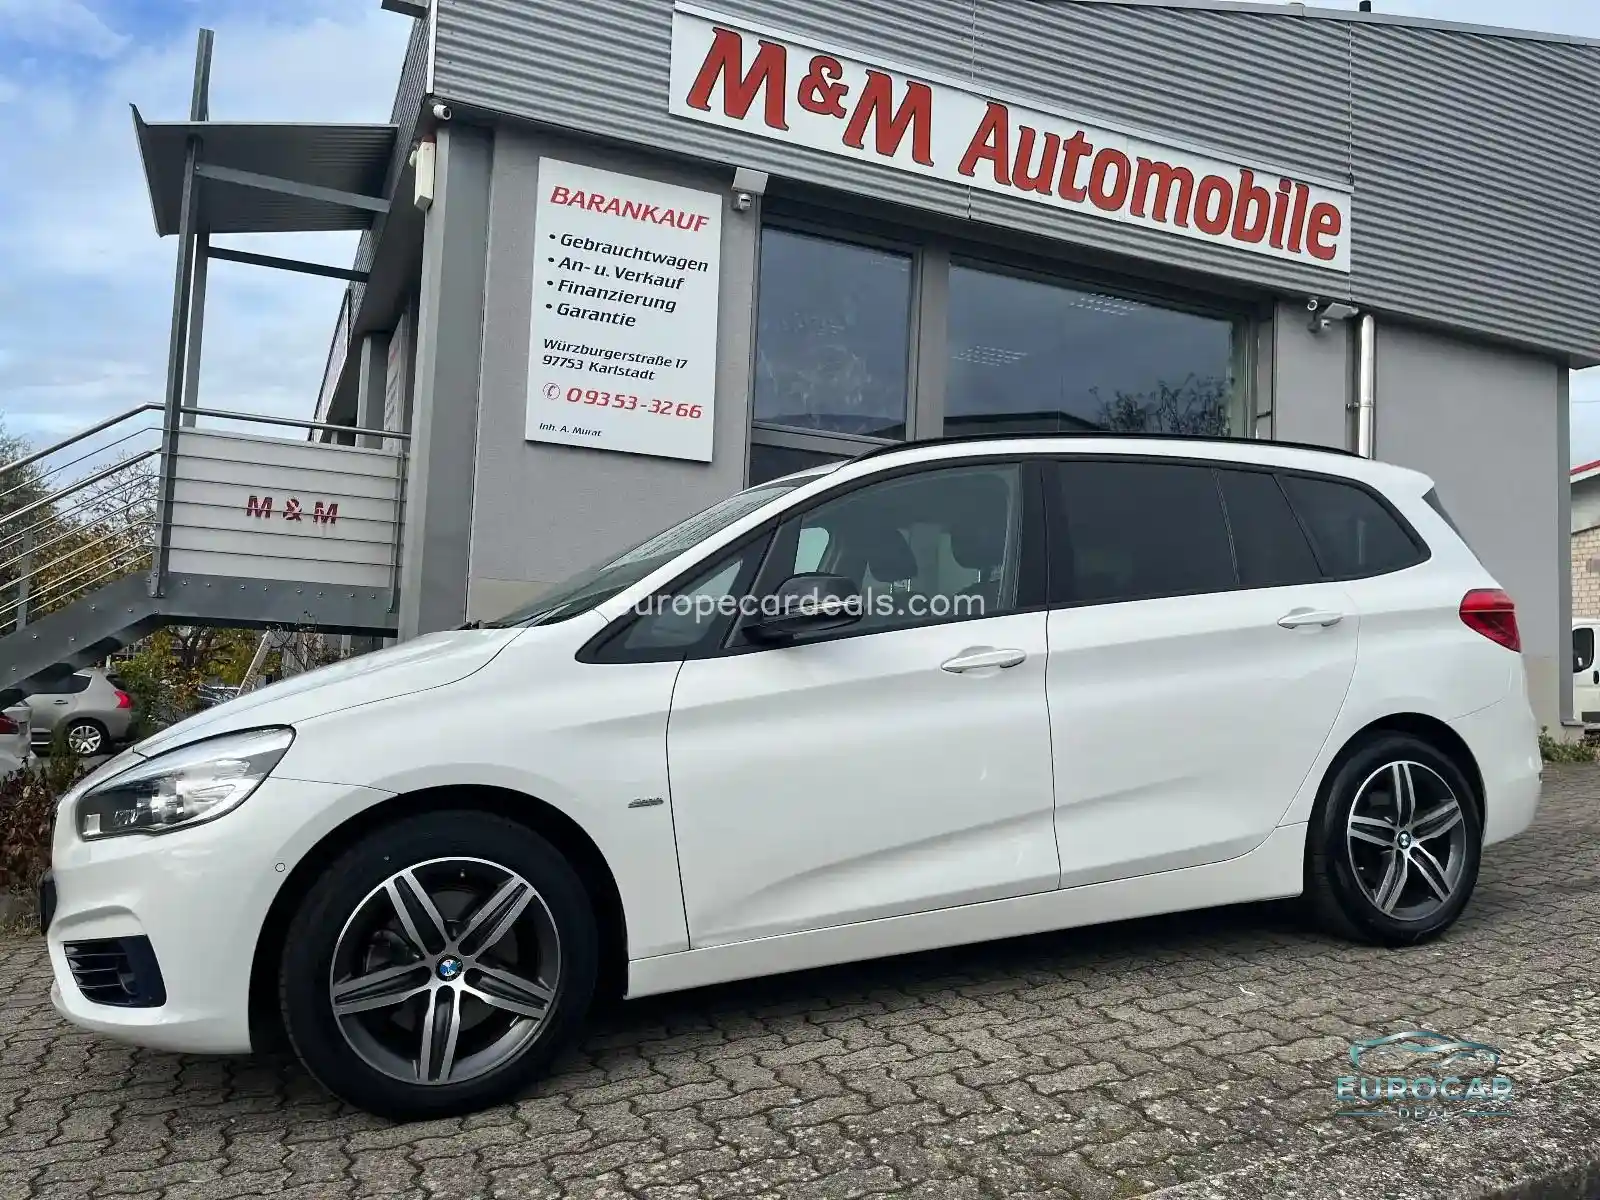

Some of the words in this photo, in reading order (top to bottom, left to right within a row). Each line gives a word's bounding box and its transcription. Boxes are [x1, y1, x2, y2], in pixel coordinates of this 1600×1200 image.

[686, 26, 935, 167] M&M
[957, 101, 1342, 261] Automobile
[550, 185, 710, 232] BARANKAUF
[560, 233, 709, 273] Gebrauchtwagen
[558, 256, 591, 272] An-
[594, 264, 610, 277] u.
[615, 266, 685, 290] Verkauf
[557, 279, 677, 313] Finanzierung
[557, 302, 636, 327] Garantie
[542, 354, 584, 370] 97753
[589, 361, 656, 380] Karlstadt
[543, 338, 673, 367] Würzburgerstraße
[675, 358, 688, 369] 17
[539, 422, 557, 432] Inh.
[560, 425, 570, 433] A.
[572, 426, 602, 437] Murat
